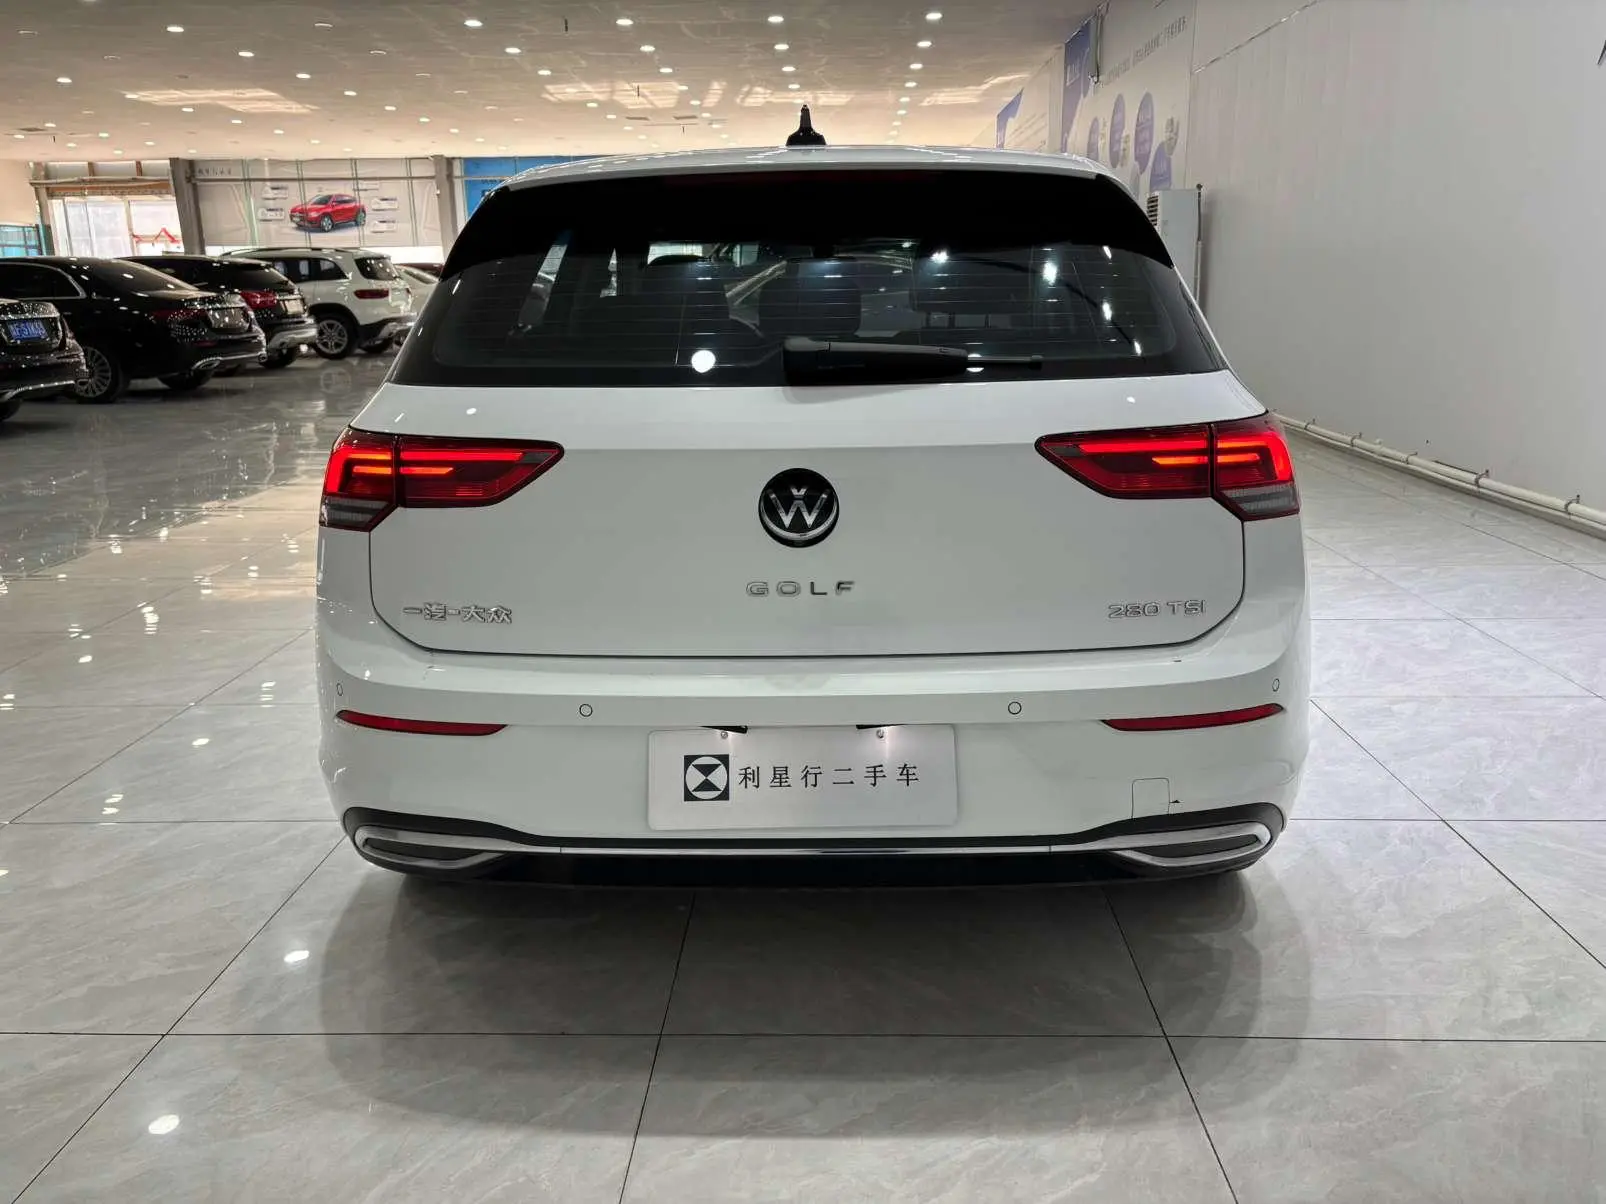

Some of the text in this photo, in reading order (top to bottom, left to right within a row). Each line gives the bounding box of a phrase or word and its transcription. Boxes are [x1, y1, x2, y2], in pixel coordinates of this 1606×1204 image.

[746, 580, 855, 597] GOLF
[1108, 600, 1205, 619] 280 TSI
[738, 763, 920, 789] 利星行二手车
